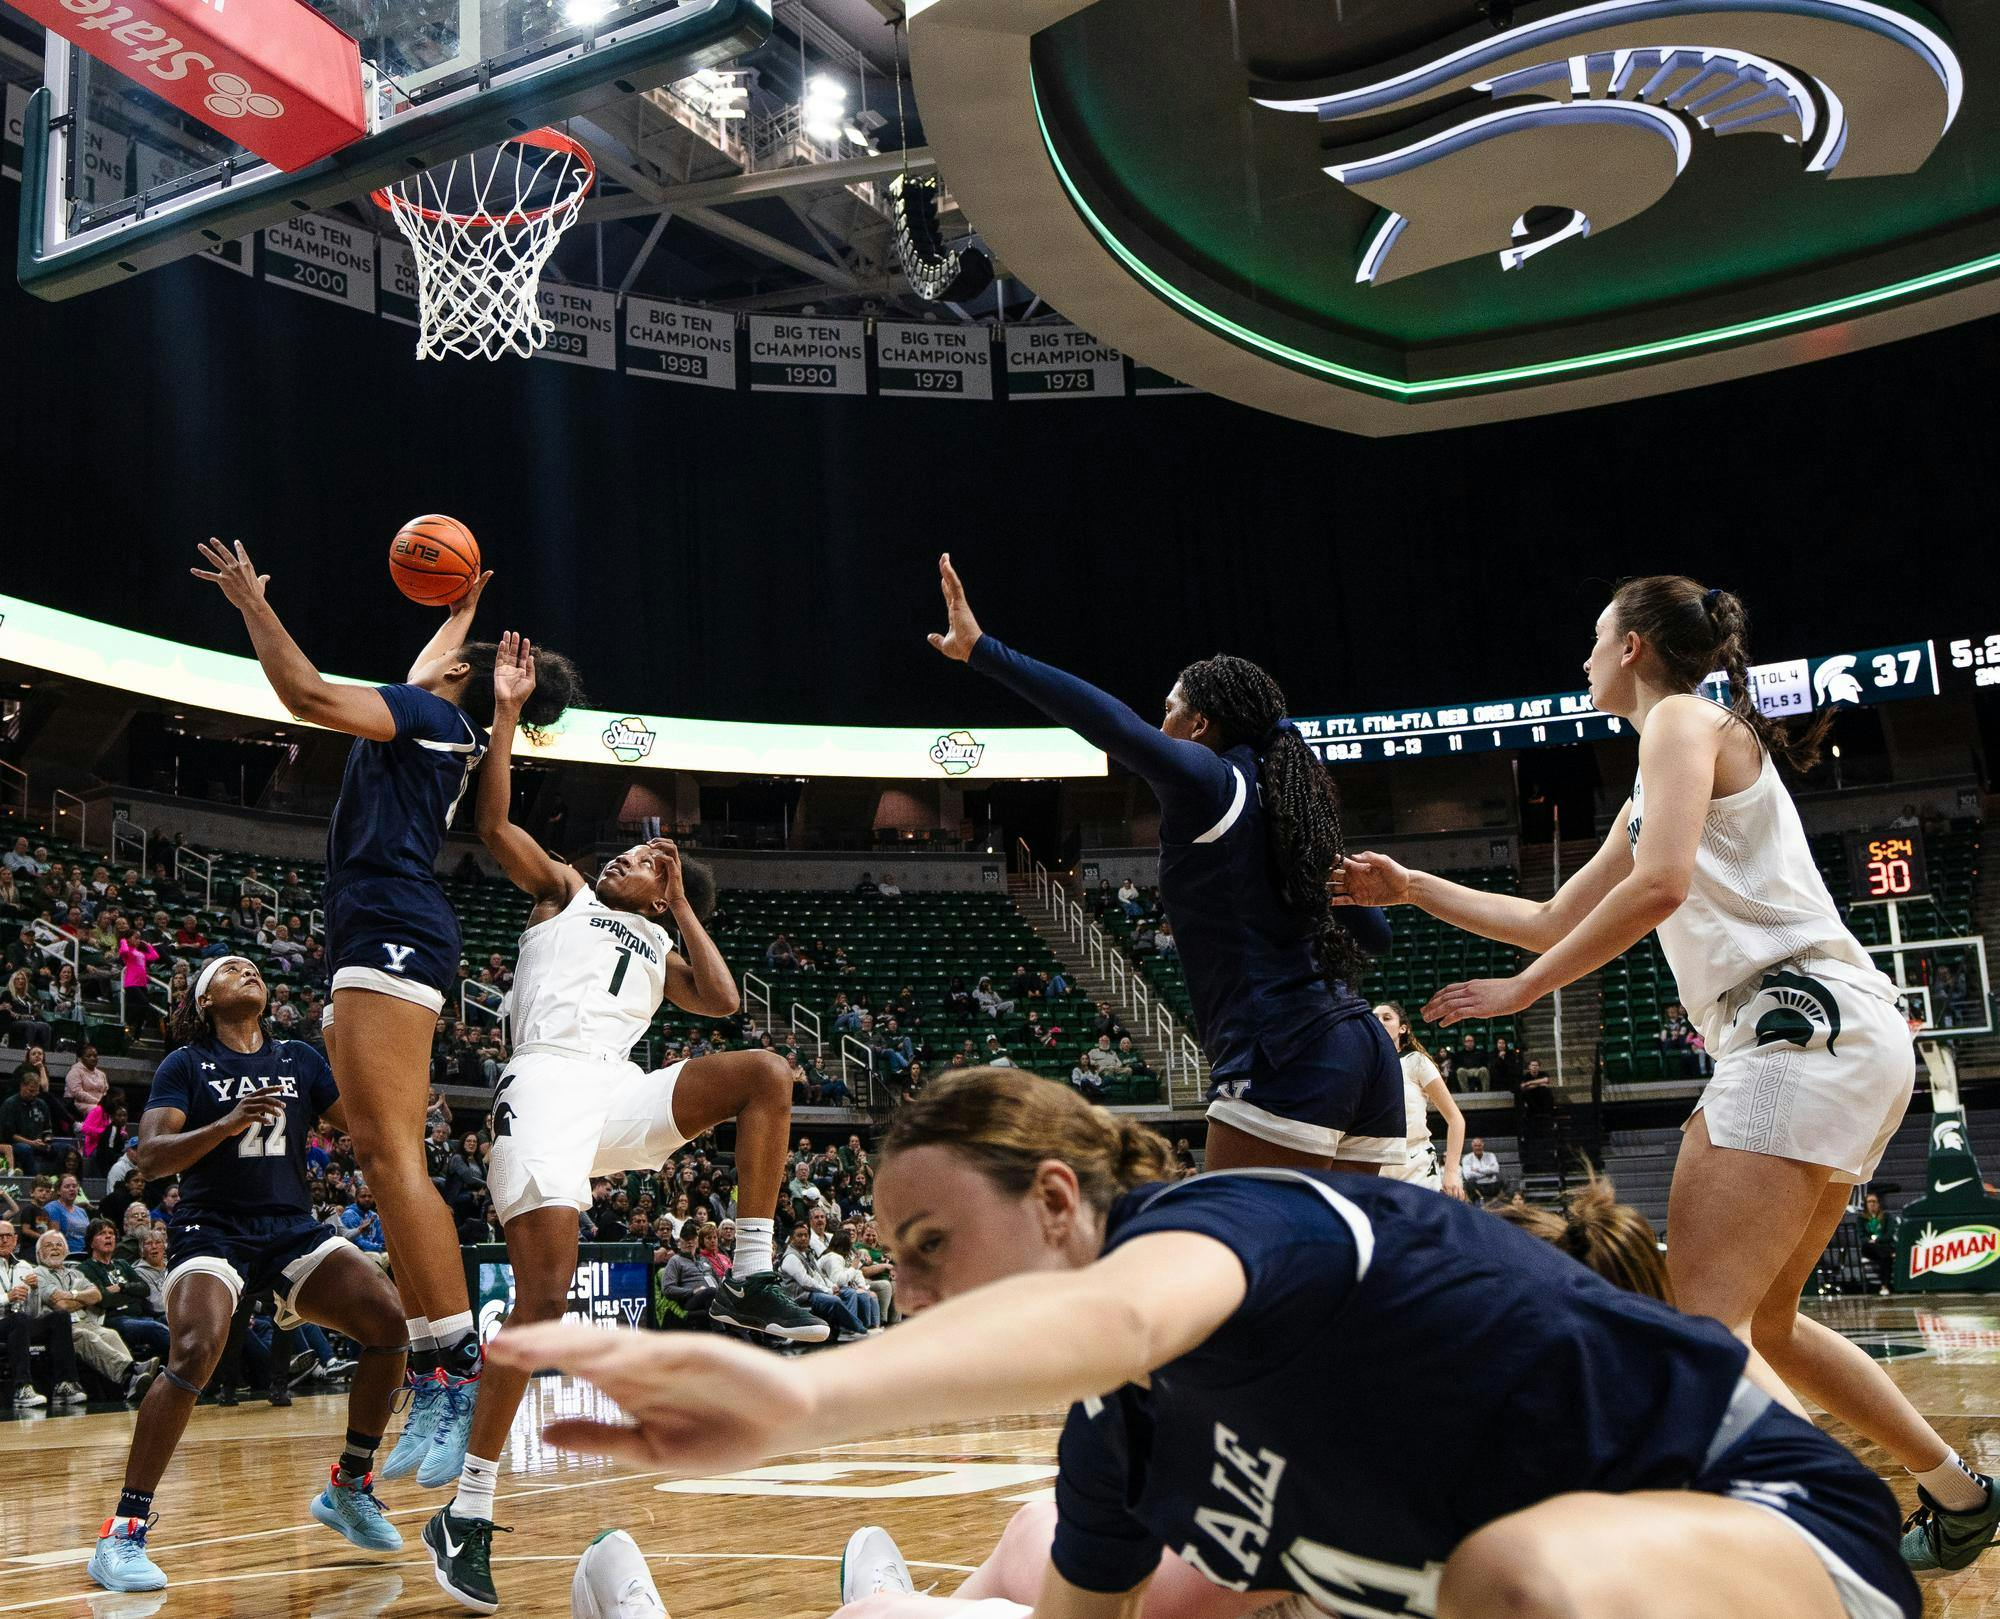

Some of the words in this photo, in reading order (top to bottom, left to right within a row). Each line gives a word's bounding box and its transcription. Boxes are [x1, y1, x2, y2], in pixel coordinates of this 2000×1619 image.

[288, 217, 315, 237] BIG
[320, 225, 351, 249] TEN
[268, 229, 372, 274] CHAMPIONS
[293, 263, 344, 293] 2000
[538, 290, 555, 306] IG
[560, 294, 592, 312] TEN
[650, 309, 677, 327] BIG
[681, 315, 712, 333] TEN
[546, 335, 583, 352] 999
[629, 325, 732, 353] CHAMPIONS
[774, 325, 803, 339] BIG
[808, 327, 841, 341] TEN
[901, 331, 929, 346] BIG
[934, 333, 967, 347] TEN
[1029, 334, 1059, 348] BIG
[1063, 333, 1098, 346] TEN
[754, 342, 862, 360] CHAMPIONS
[881, 348, 988, 365] CHAMPIONS
[1010, 348, 1120, 366] CHAMPIONS
[660, 354, 703, 375] 1998
[785, 367, 832, 384] 1990
[914, 372, 957, 389] 1979
[1044, 373, 1088, 389] 1978
[395, 539, 440, 563] ELITE
[1760, 672, 1786, 685] TOL
[1790, 669, 1799, 680] 4
[1871, 649, 1922, 688] 37
[1762, 694, 1789, 709] FLS
[1793, 692, 1802, 705] 3
[1326, 719, 1357, 736] FT%
[1362, 712, 1434, 733] FTM-FTA
[1437, 708, 1469, 727] REB
[1519, 699, 1552, 718] AST
[1559, 694, 1594, 714] BLK
[1448, 734, 1463, 751] 11
[1492, 730, 1501, 747] 1
[1531, 725, 1546, 743] 11
[1575, 721, 1584, 738] 1
[1607, 717, 1621, 734] 4
[1868, 839, 1913, 861] 5:24
[983, 871, 998, 880] 133
[1084, 868, 1098, 876] 133
[1867, 860, 1912, 895] 30
[589, 917, 658, 965] SPARTANS
[382, 942, 416, 973] Y
[608, 946, 632, 997] 1
[208, 1076, 299, 1102] YALE
[238, 1106, 287, 1158] 22
[1911, 1233, 1996, 1276] LIBMAN
[591, 1262, 610, 1297] 11
